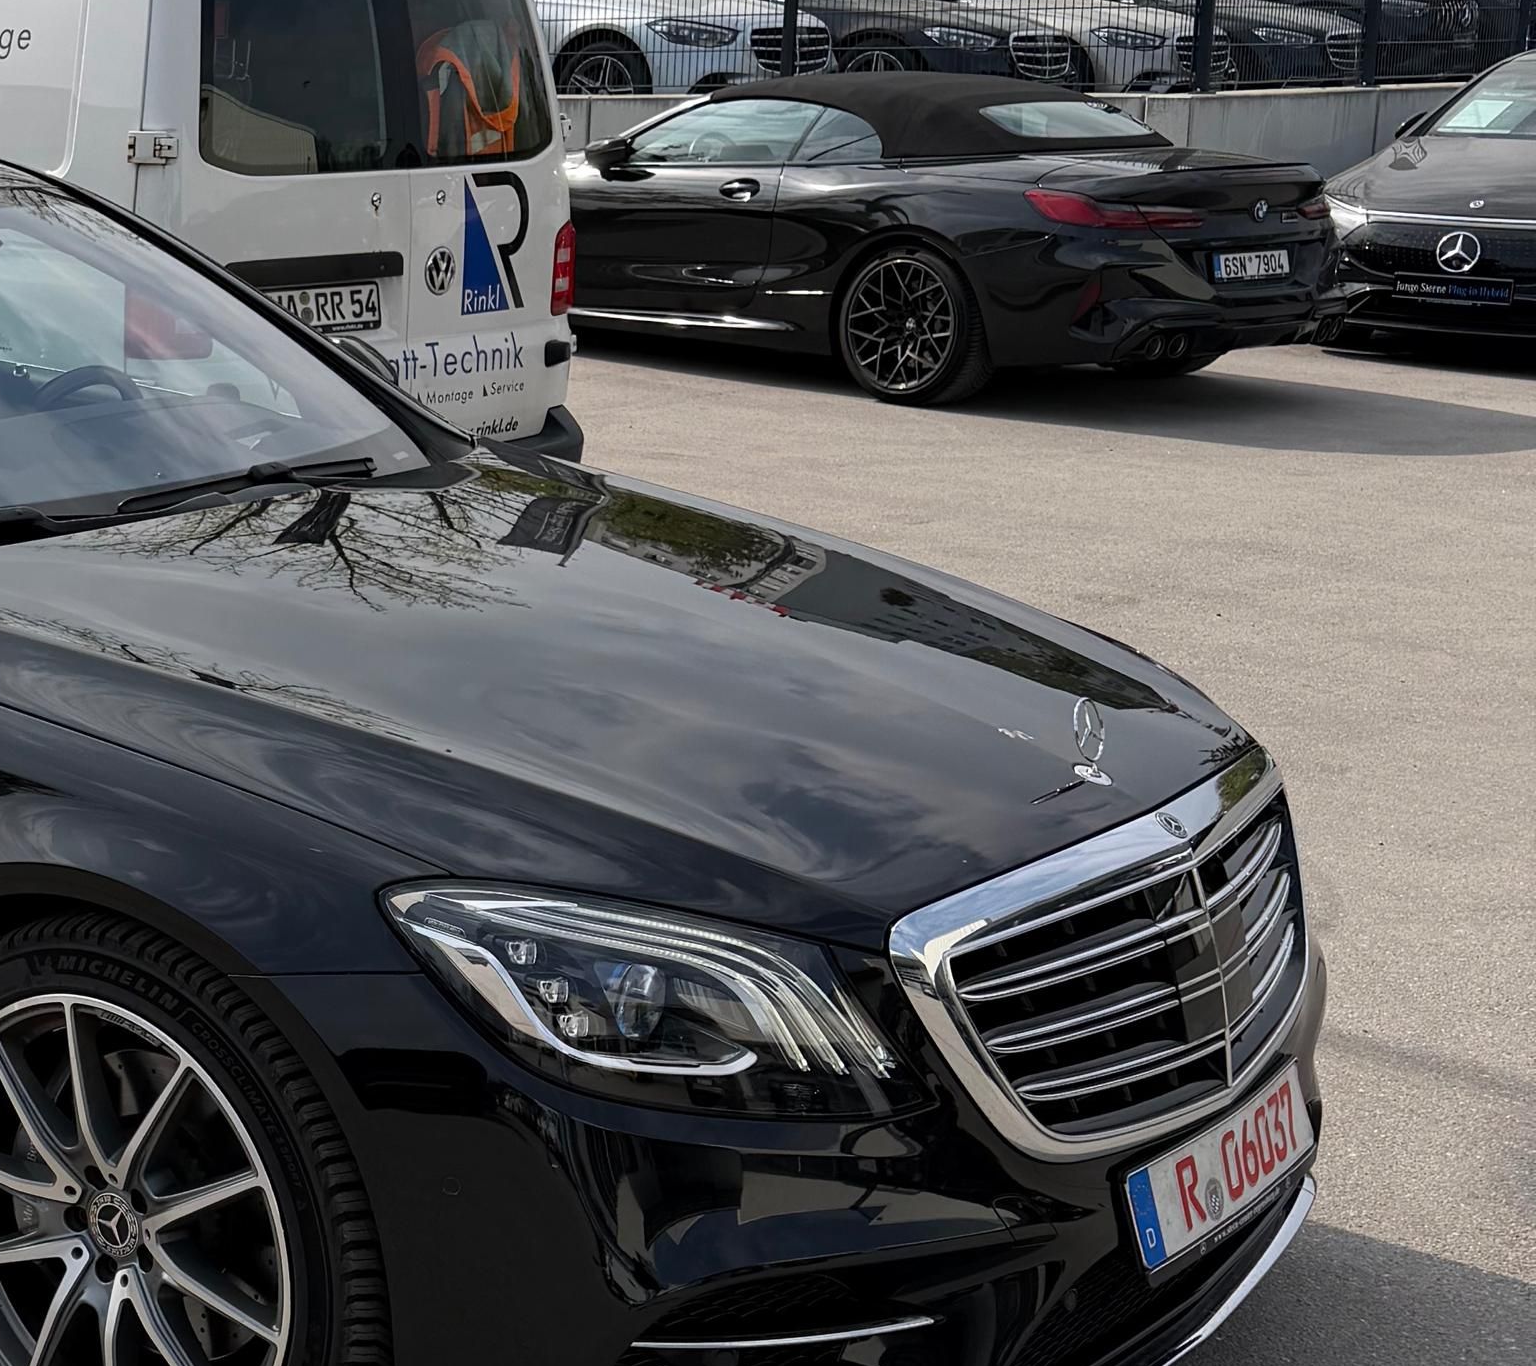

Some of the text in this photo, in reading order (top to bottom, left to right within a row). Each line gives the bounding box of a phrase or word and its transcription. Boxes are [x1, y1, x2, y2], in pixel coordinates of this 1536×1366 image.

[1224, 253, 1284, 277] 6SN 7904
[464, 284, 501, 312] Rinkl
[1420, 282, 1446, 295] Sterne
[314, 291, 345, 322] RR
[350, 288, 377, 318] 54
[426, 381, 525, 404] Montage Service
[470, 416, 519, 436] rinkl.de
[56, 954, 181, 1011] MICHELIN
[1175, 1154, 1207, 1233] R
[1220, 1080, 1297, 1202] 06037
[1146, 1227, 1157, 1248] D
